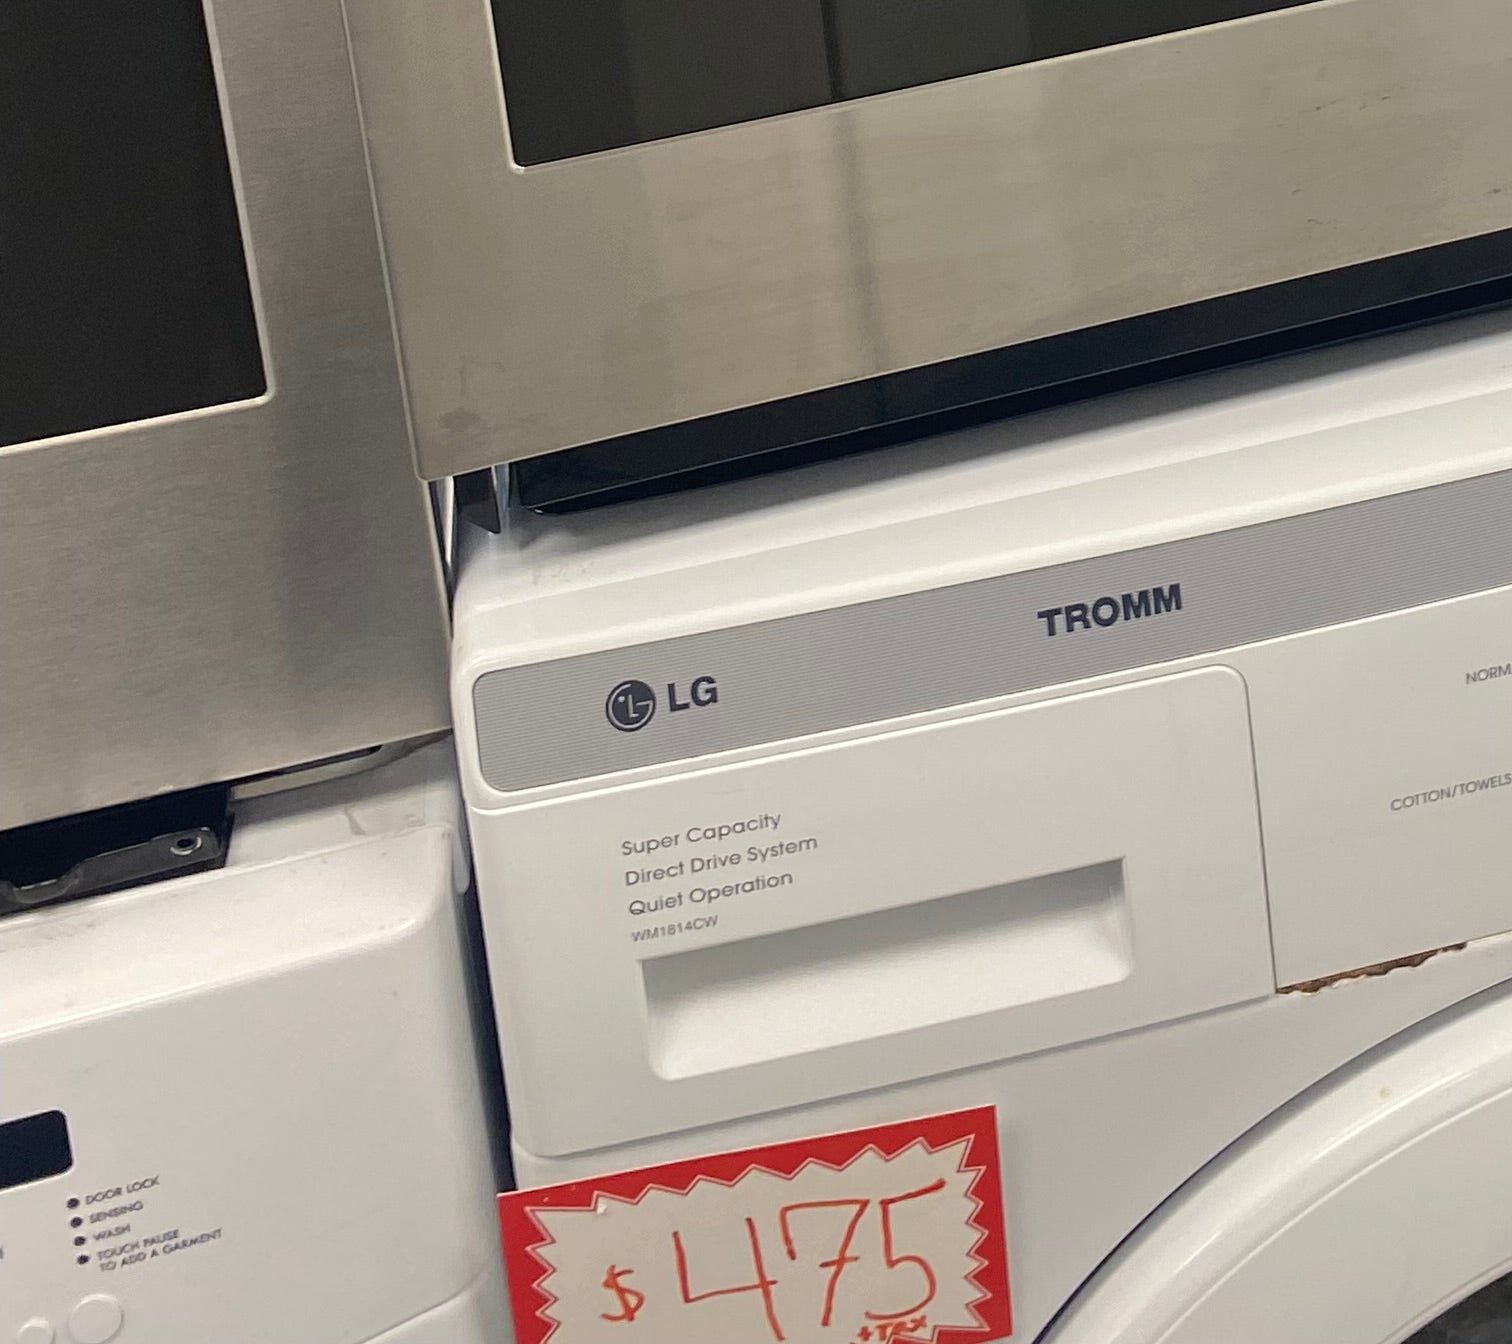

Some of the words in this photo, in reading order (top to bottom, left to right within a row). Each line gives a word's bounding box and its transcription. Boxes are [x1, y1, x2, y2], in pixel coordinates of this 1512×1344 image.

[1037, 583, 1183, 636] TROMM
[666, 675, 720, 713] LG
[1389, 773, 1512, 812] COTTON/TOWELS
[621, 833, 680, 857] Super
[686, 814, 782, 841] Capacity
[625, 860, 685, 887] Direct
[690, 851, 742, 874] Drive
[747, 836, 818, 863] System
[628, 892, 683, 916] Quiet
[689, 870, 794, 904] Operation
[631, 914, 719, 943] WM1814CW
[84, 1187, 123, 1205] DOOR
[126, 1175, 160, 1194] LOCK
[89, 1200, 144, 1223] SENSING
[92, 1223, 131, 1241] WASH
[97, 1241, 140, 1261] TOUCH
[142, 1229, 179, 1247] PAUSE
[99, 1260, 117, 1272] TO
[121, 1251, 147, 1266] ADD
[150, 1248, 159, 1258] A
[162, 1227, 223, 1254] GARMENT
